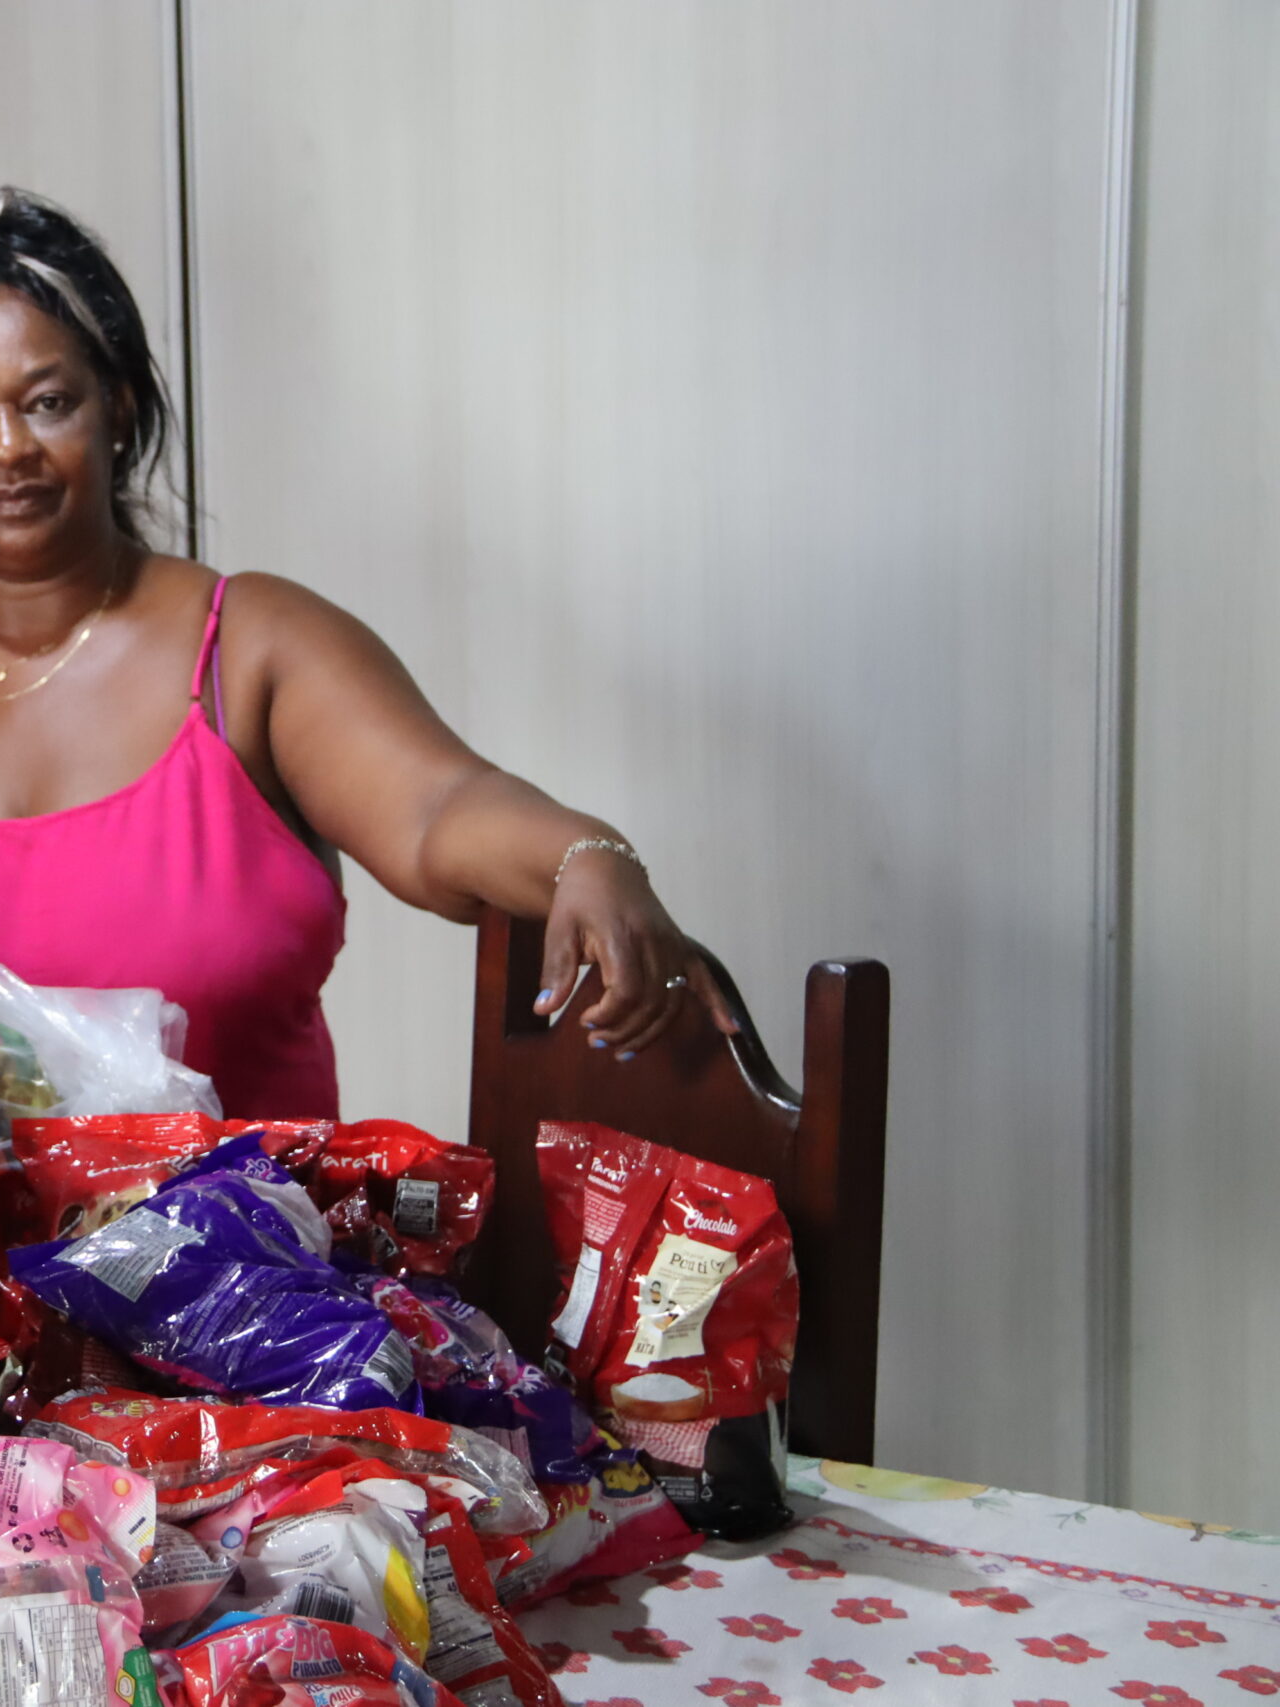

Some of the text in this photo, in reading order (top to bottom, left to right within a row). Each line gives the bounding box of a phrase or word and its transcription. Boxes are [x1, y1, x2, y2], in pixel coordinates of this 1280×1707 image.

[320, 1151, 389, 1172] arati
[683, 1209, 738, 1236] Chocolate
[296, 1624, 337, 1661] BIG
[293, 1659, 342, 1677] PIRULITO
